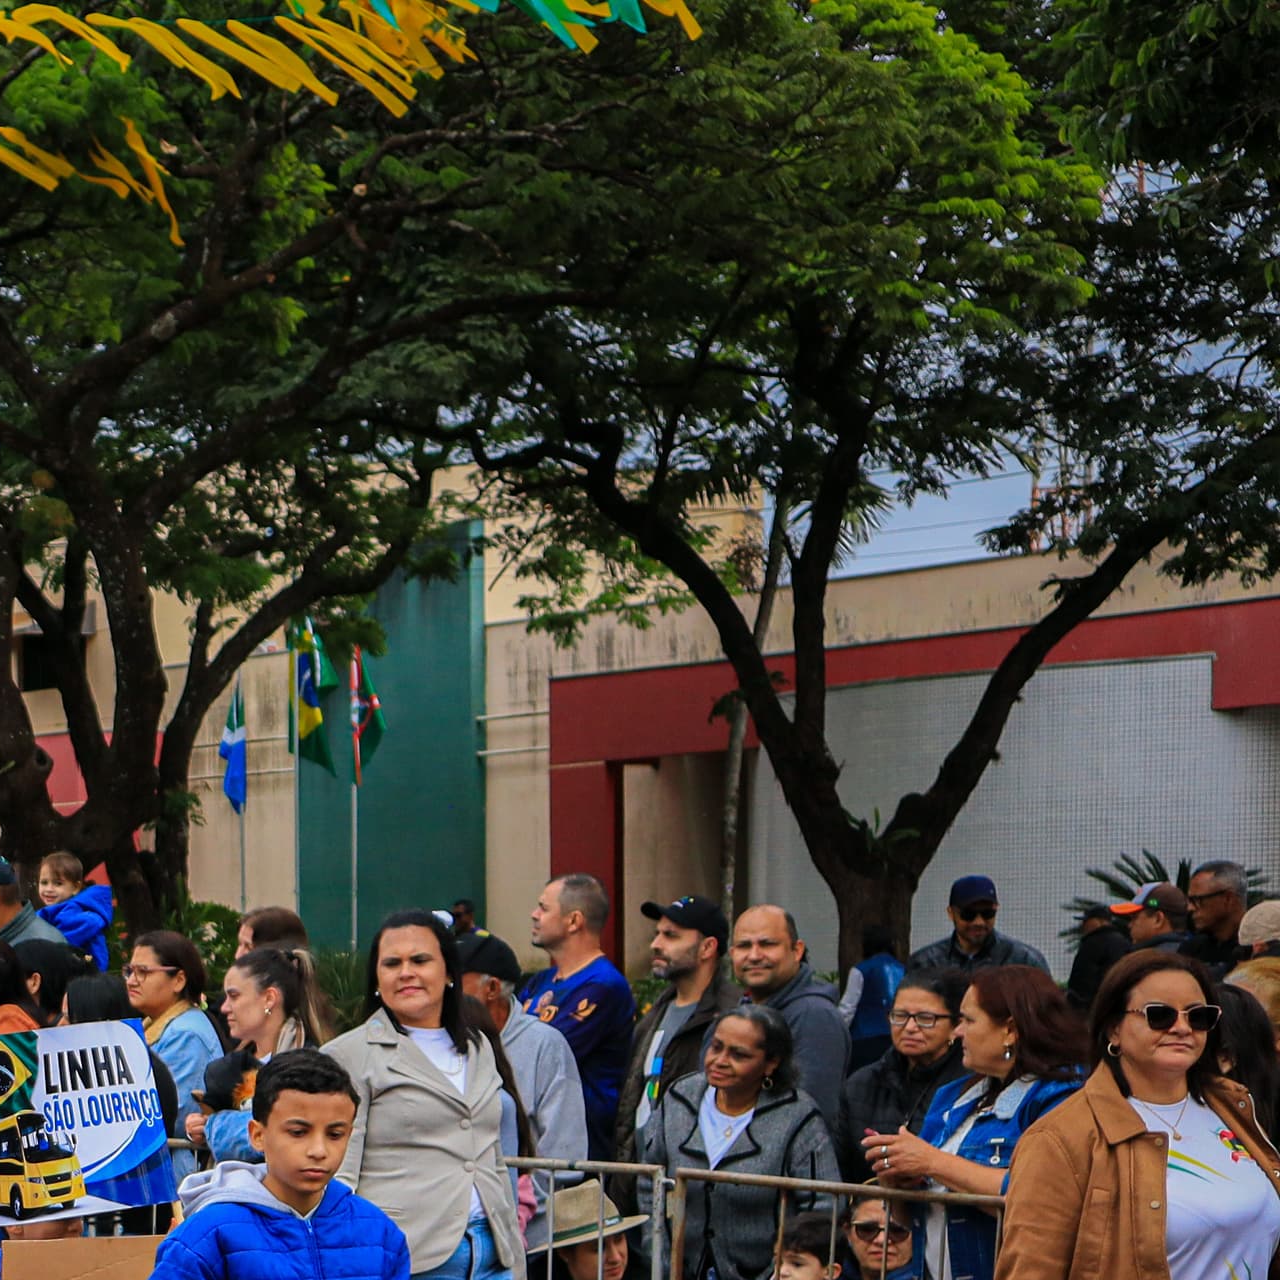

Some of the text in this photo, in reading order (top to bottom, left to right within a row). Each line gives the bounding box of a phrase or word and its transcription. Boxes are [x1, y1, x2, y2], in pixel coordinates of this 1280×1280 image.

[43, 1045, 135, 1095] LINHA
[43, 1088, 163, 1133] SÃO LOURENÇO
